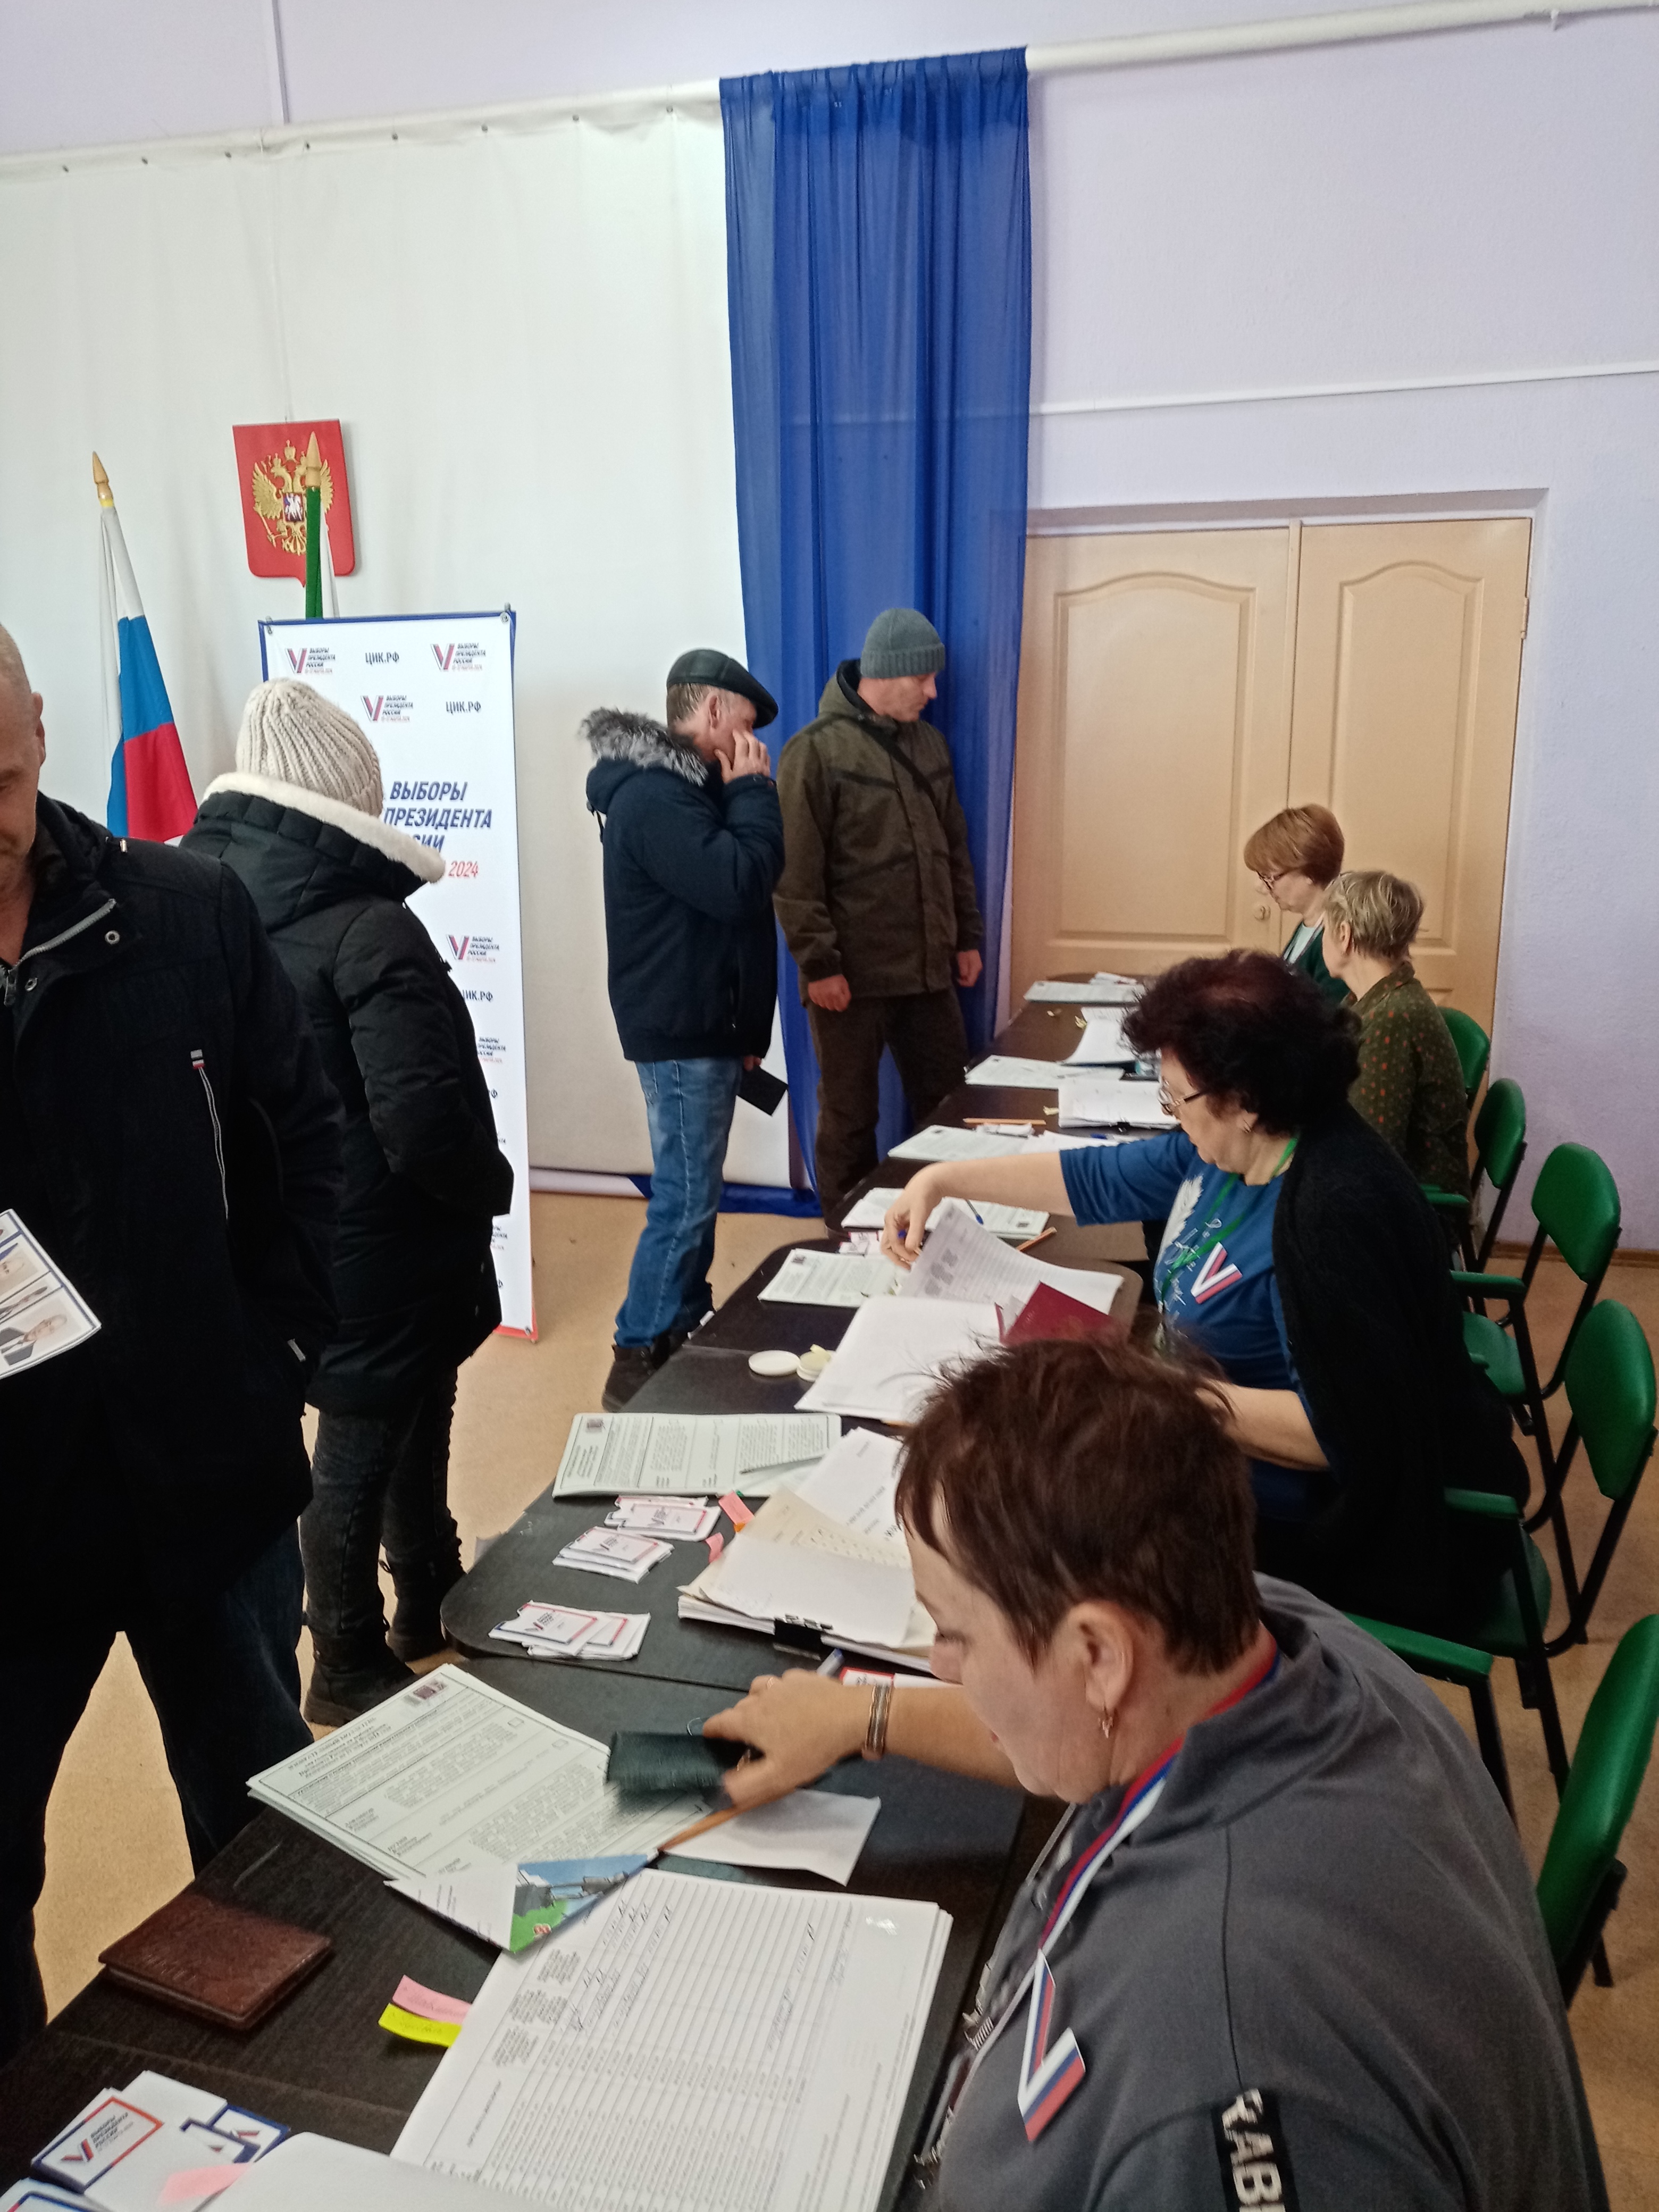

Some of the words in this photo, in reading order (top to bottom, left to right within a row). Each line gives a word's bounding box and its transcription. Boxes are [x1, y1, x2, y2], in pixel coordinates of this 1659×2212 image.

[365, 651, 400, 666] ЦИК.РФ
[446, 701, 481, 715] ЦИК.РФ
[389, 781, 468, 801] ВЫБОРЫ
[384, 807, 492, 830] ПРЕЗИДЕНТА
[448, 860, 479, 878] 2024
